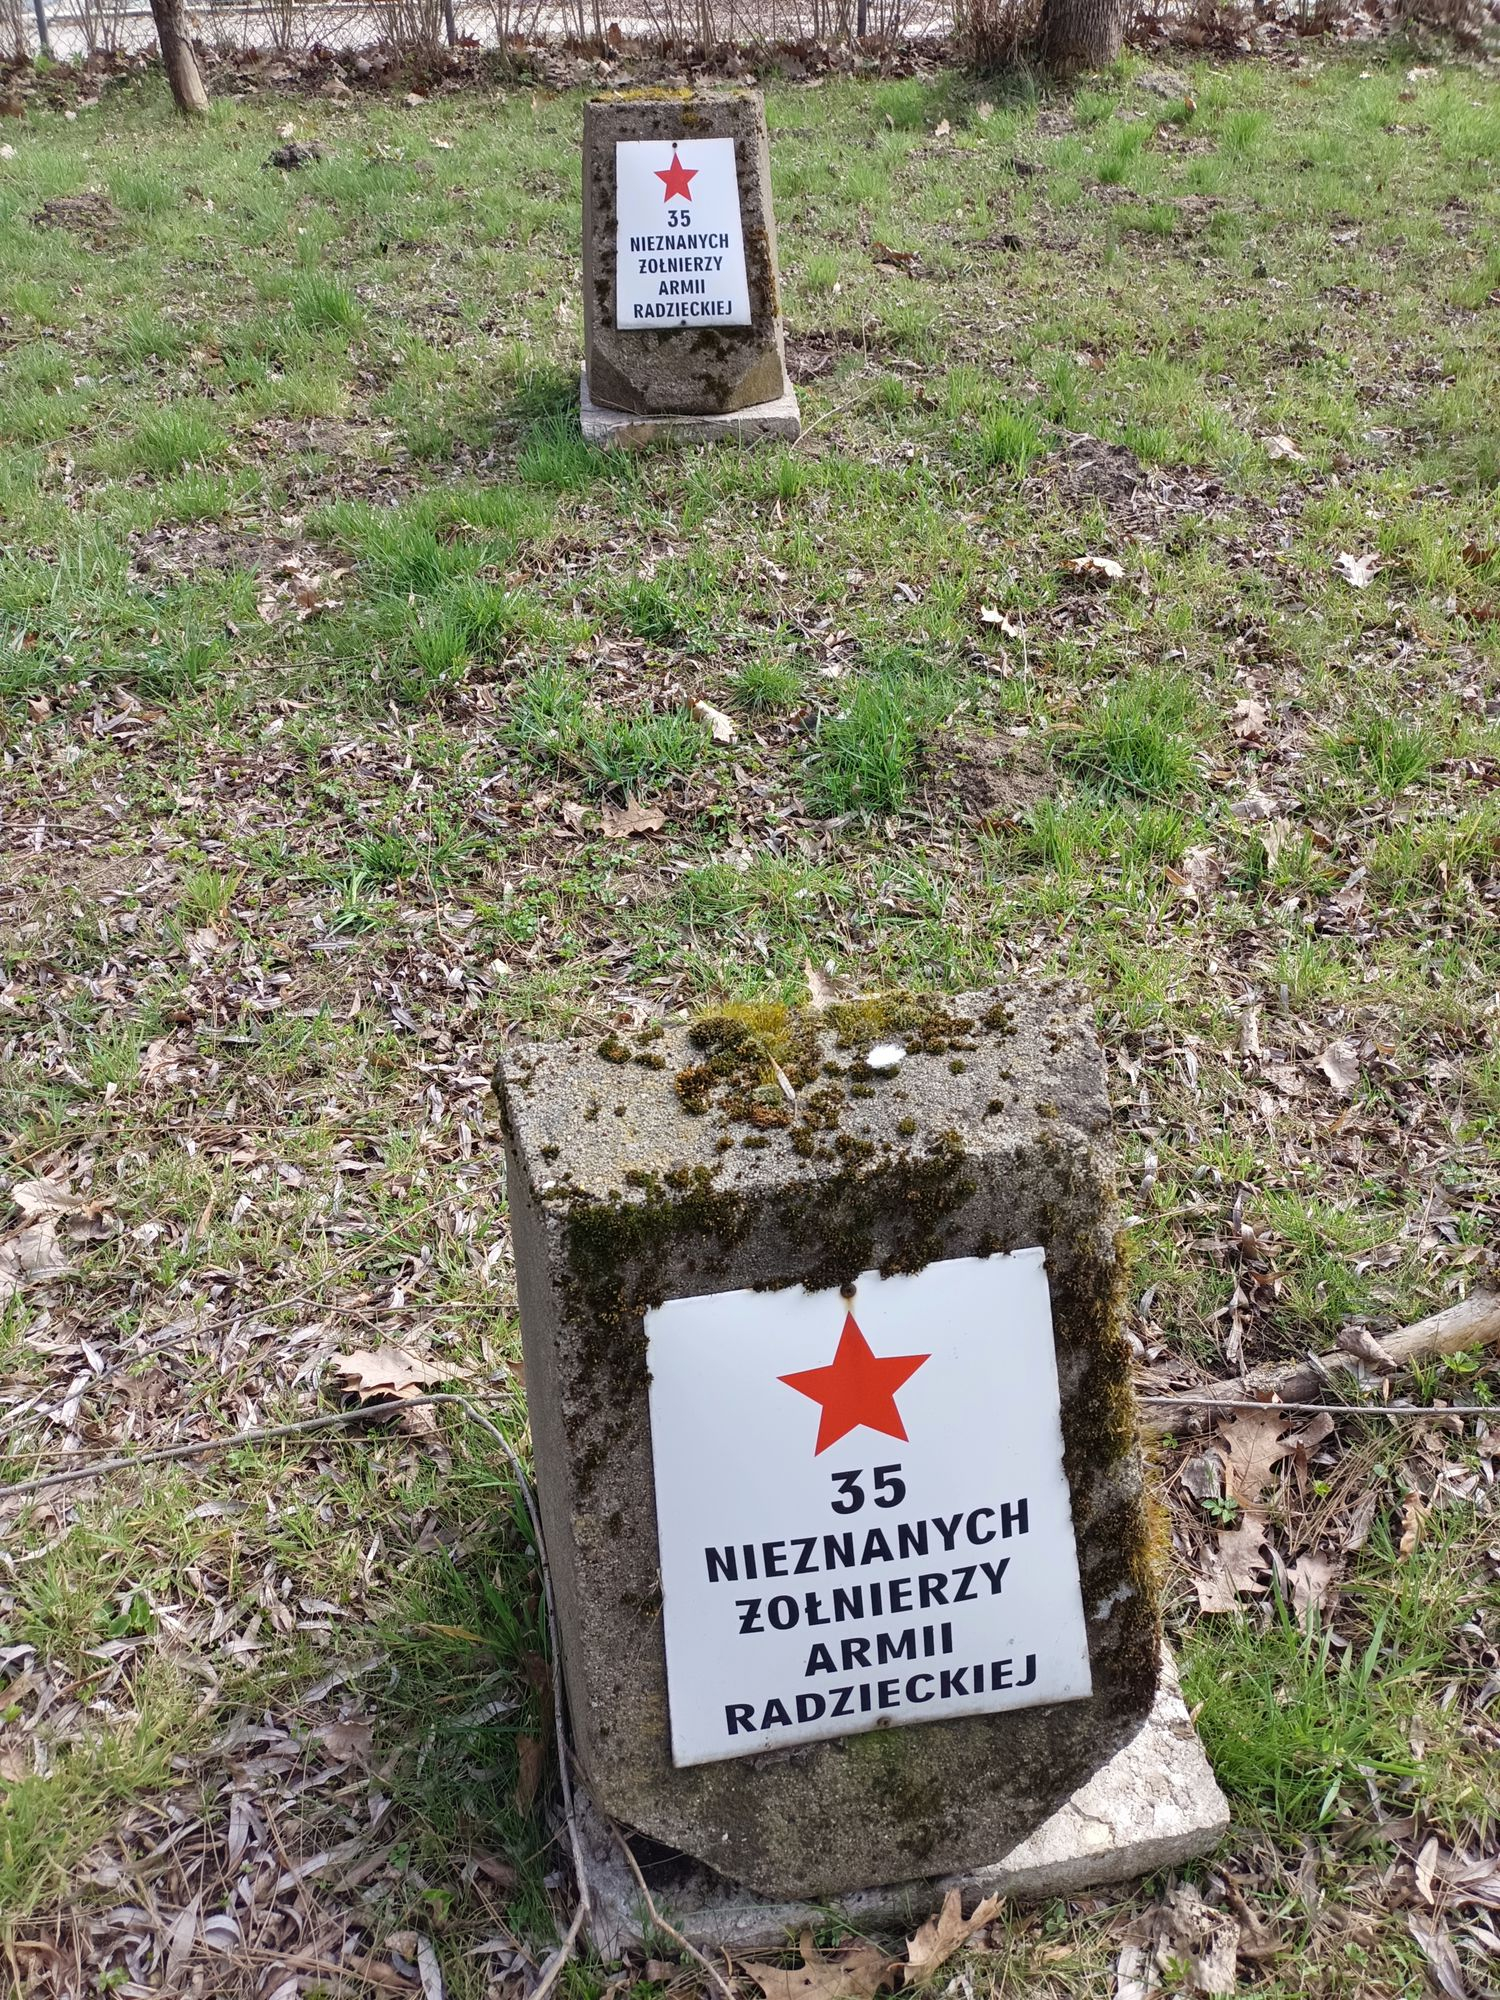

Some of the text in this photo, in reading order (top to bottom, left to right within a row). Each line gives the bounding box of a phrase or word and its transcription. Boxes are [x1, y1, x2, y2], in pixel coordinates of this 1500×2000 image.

[667, 210, 691, 228] 35
[630, 233, 729, 252] NIEZNANYCH
[658, 279, 705, 296] ARMII
[633, 300, 732, 319] RADZIECKIEJ
[831, 1463, 906, 1515] 35
[704, 1498, 1029, 1583] NIEZNANYCH
[804, 1622, 953, 1677] ARMII
[724, 1653, 1037, 1736] RADZIECKIEJ
